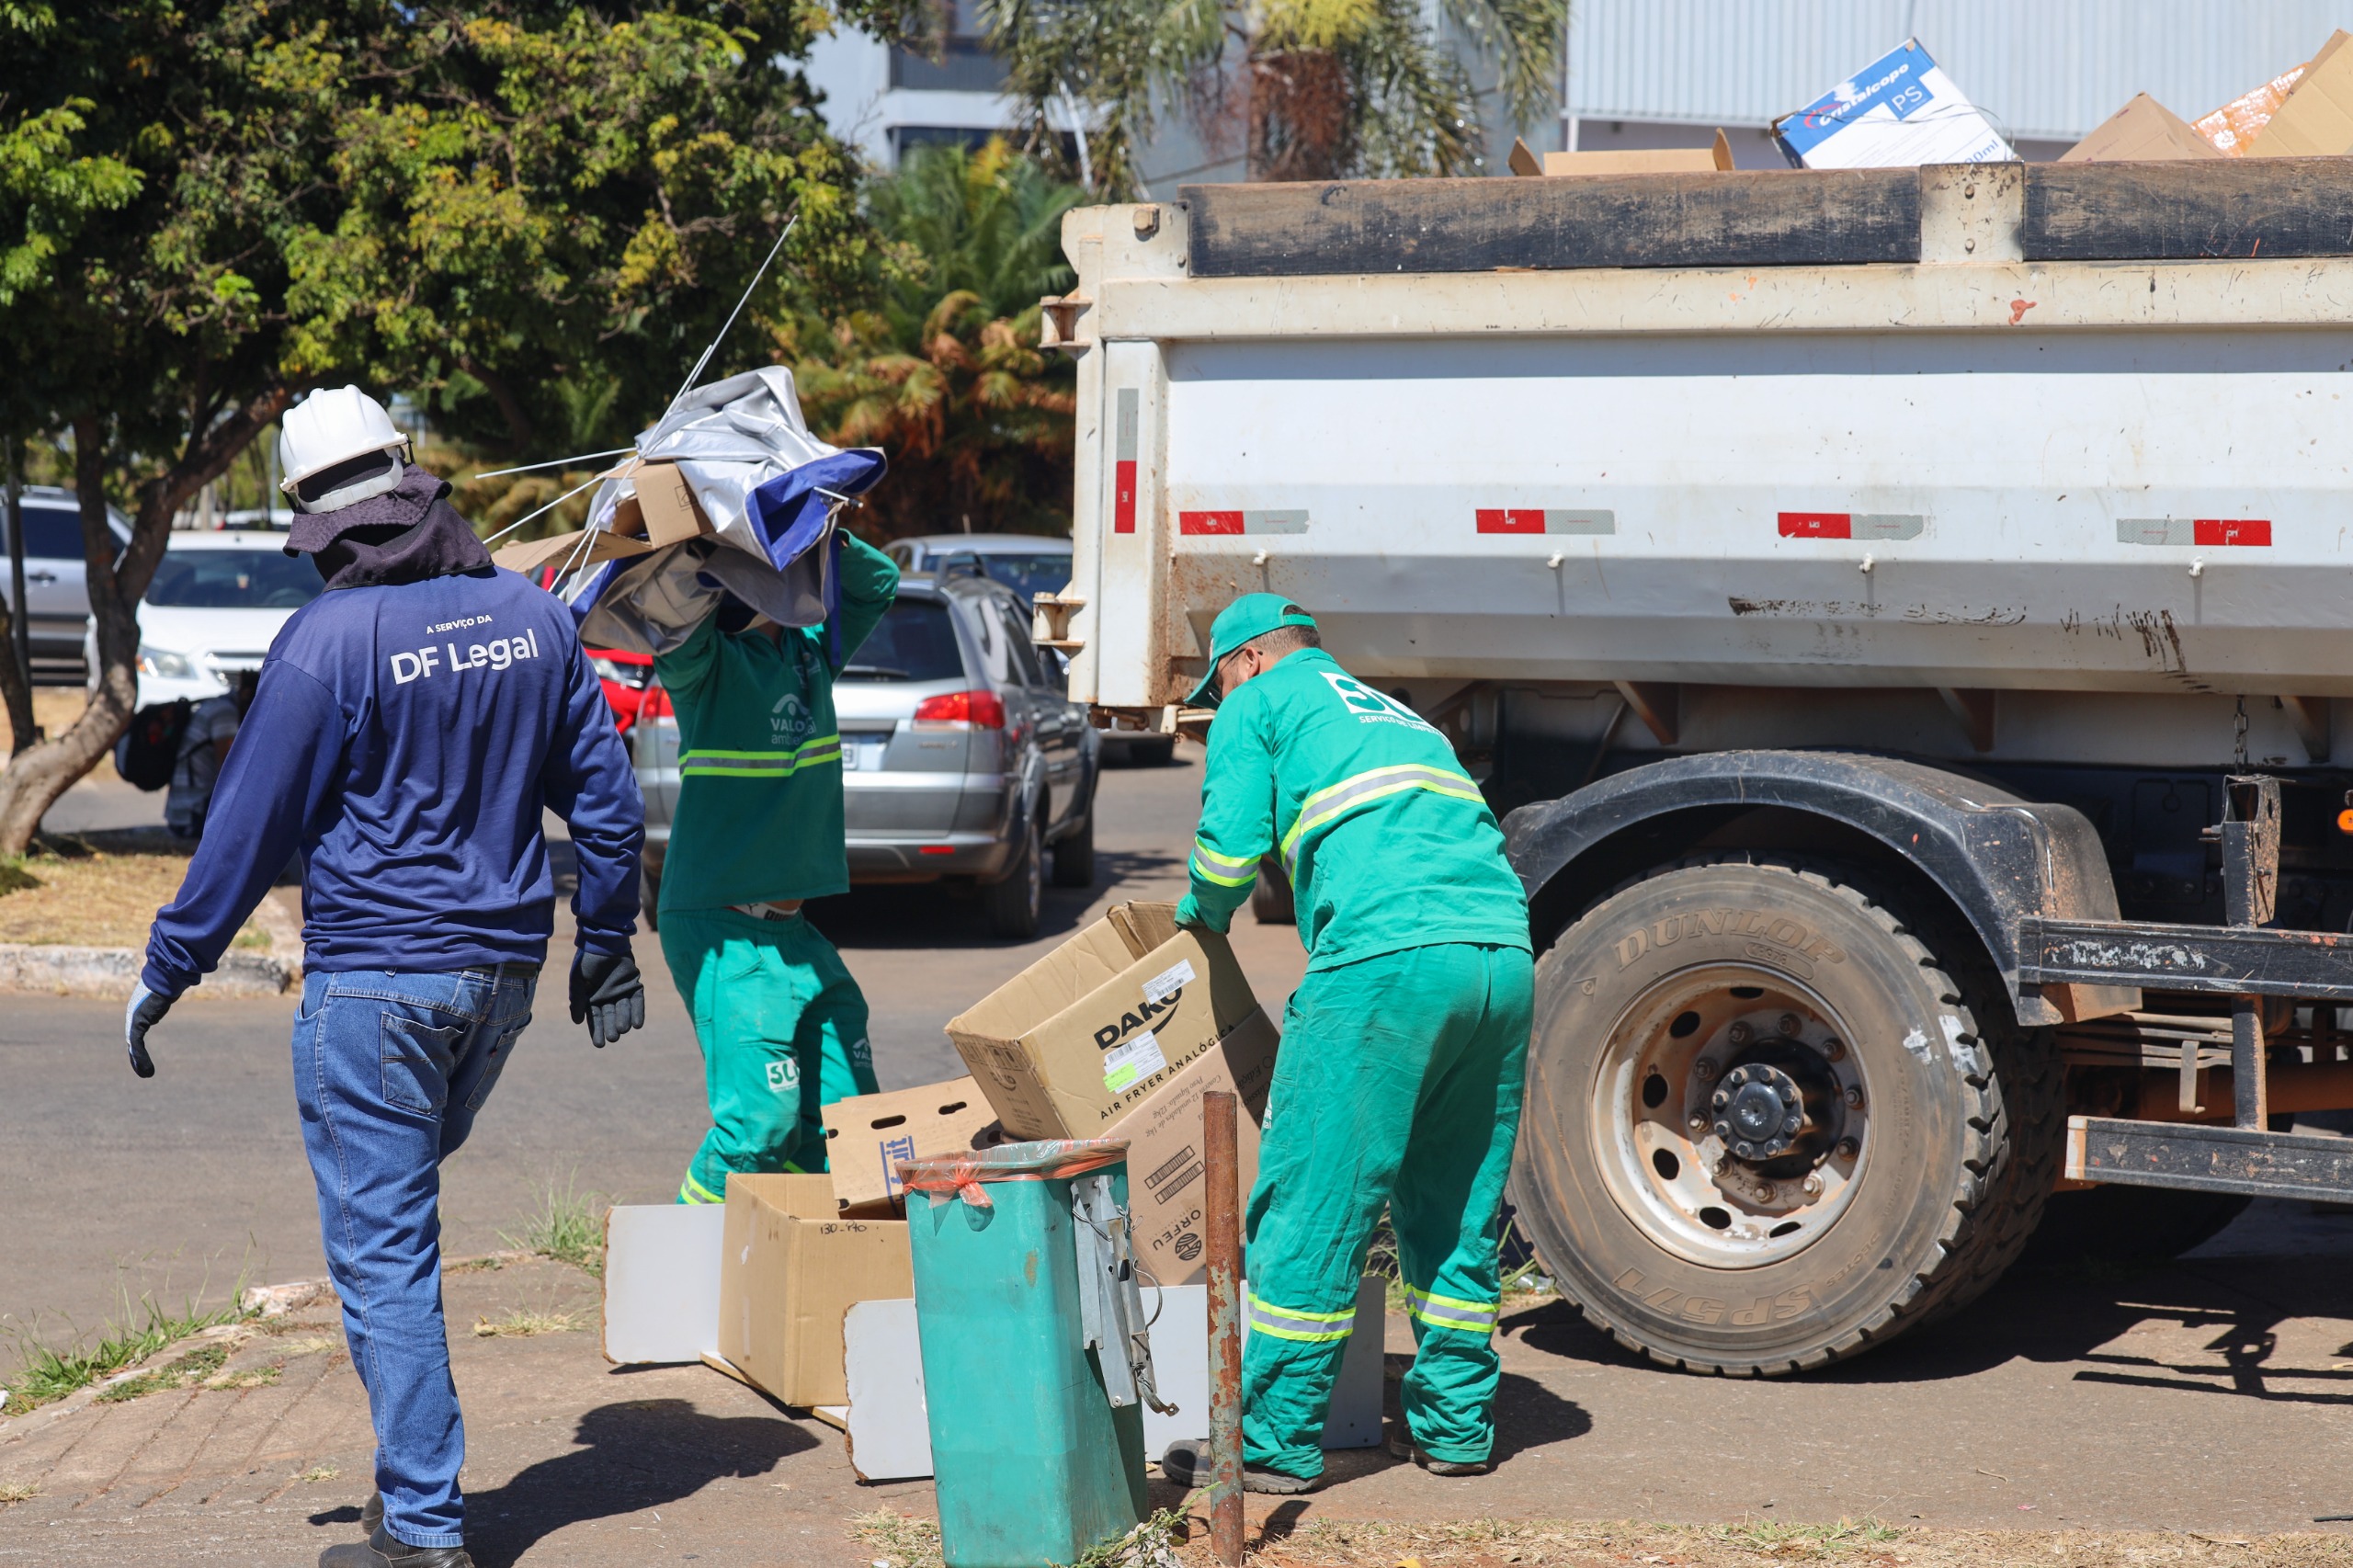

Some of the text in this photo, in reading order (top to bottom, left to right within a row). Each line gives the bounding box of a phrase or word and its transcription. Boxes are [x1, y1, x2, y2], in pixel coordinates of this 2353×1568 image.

[1891, 85, 1923, 113] PS
[426, 614, 493, 634] A SERVIÇO DA
[390, 628, 539, 685] DF Legal
[1615, 907, 1847, 972] DUNLOP
[1094, 986, 1183, 1051] DAKO
[1100, 1102, 1122, 1120] AIR
[1125, 1074, 1164, 1102] FRYER
[1168, 1024, 1236, 1075] ANALÓGICA
[1189, 1075, 1203, 1089] Peso
[1165, 1098, 1191, 1120] unidades
[1190, 1092, 1199, 1102] 12
[1154, 1105, 1168, 1119] 12kg
[1156, 1118, 1164, 1129] de
[1146, 1125, 1157, 1138] 1kg
[1152, 1210, 1201, 1252] ORFEU
[1612, 1267, 1814, 1326] SP571
